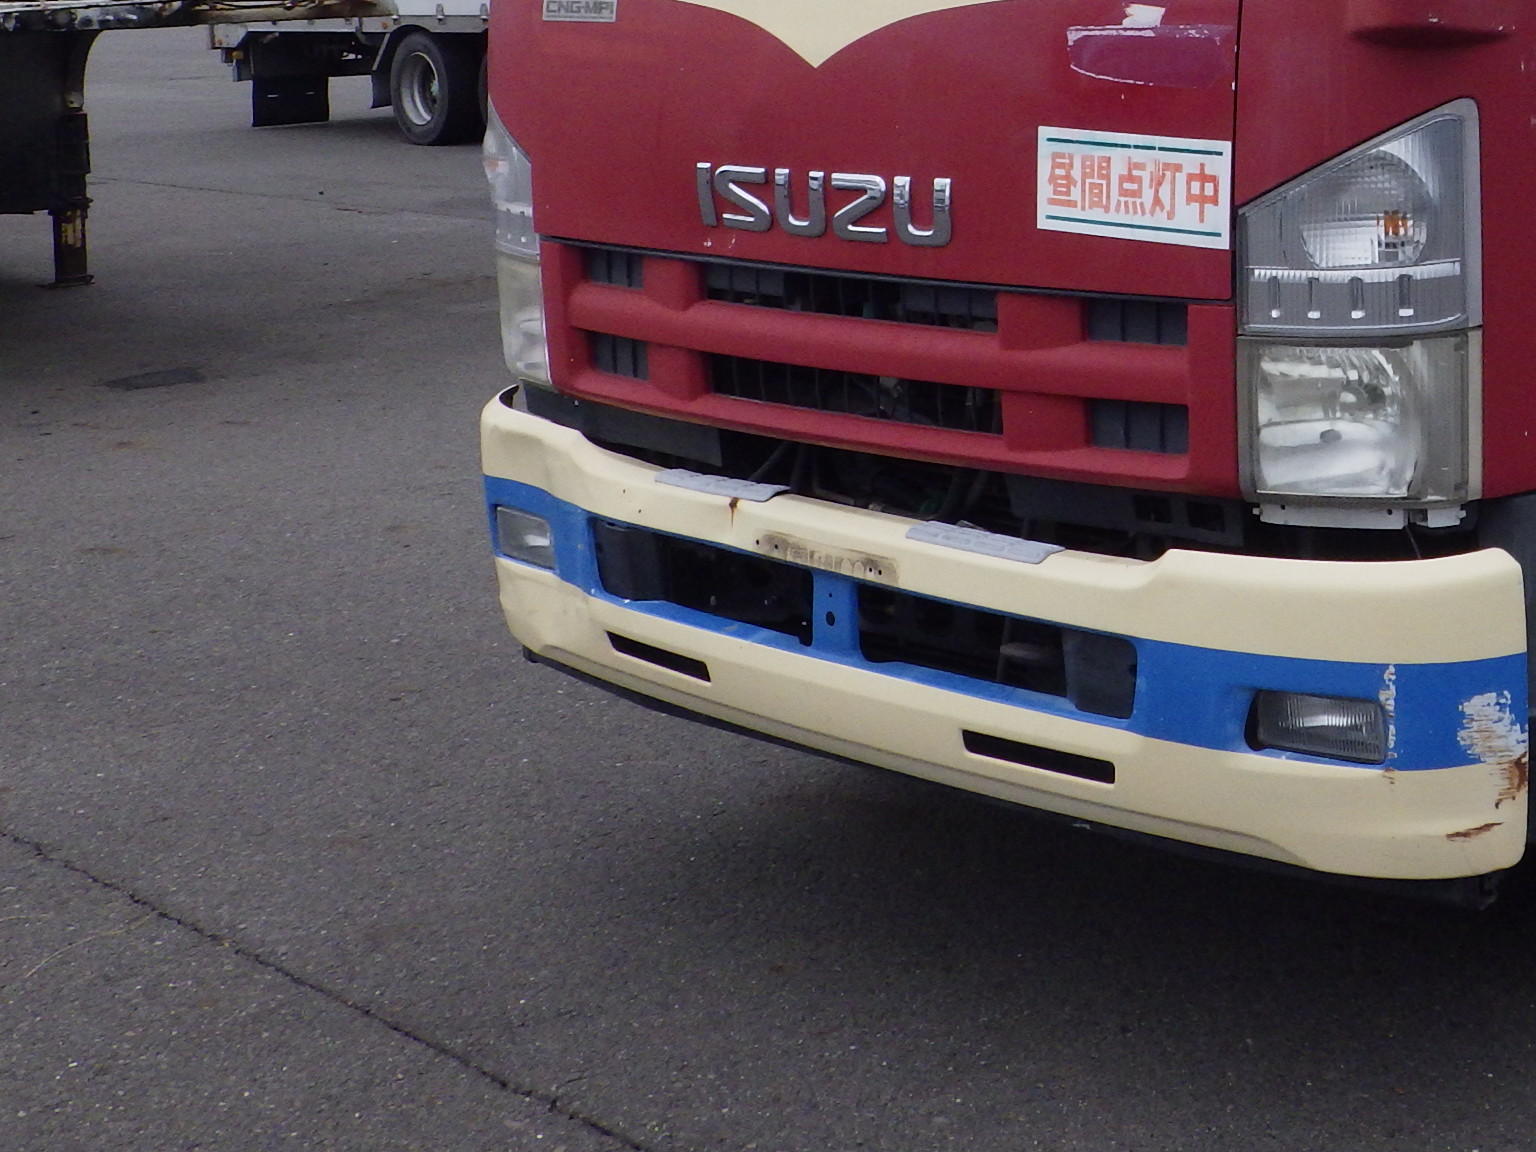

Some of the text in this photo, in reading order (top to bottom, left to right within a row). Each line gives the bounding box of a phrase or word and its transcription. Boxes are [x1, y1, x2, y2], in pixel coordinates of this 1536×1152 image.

[696, 161, 952, 248] ISUZU
[1047, 151, 1220, 224] 昼間点灯中
